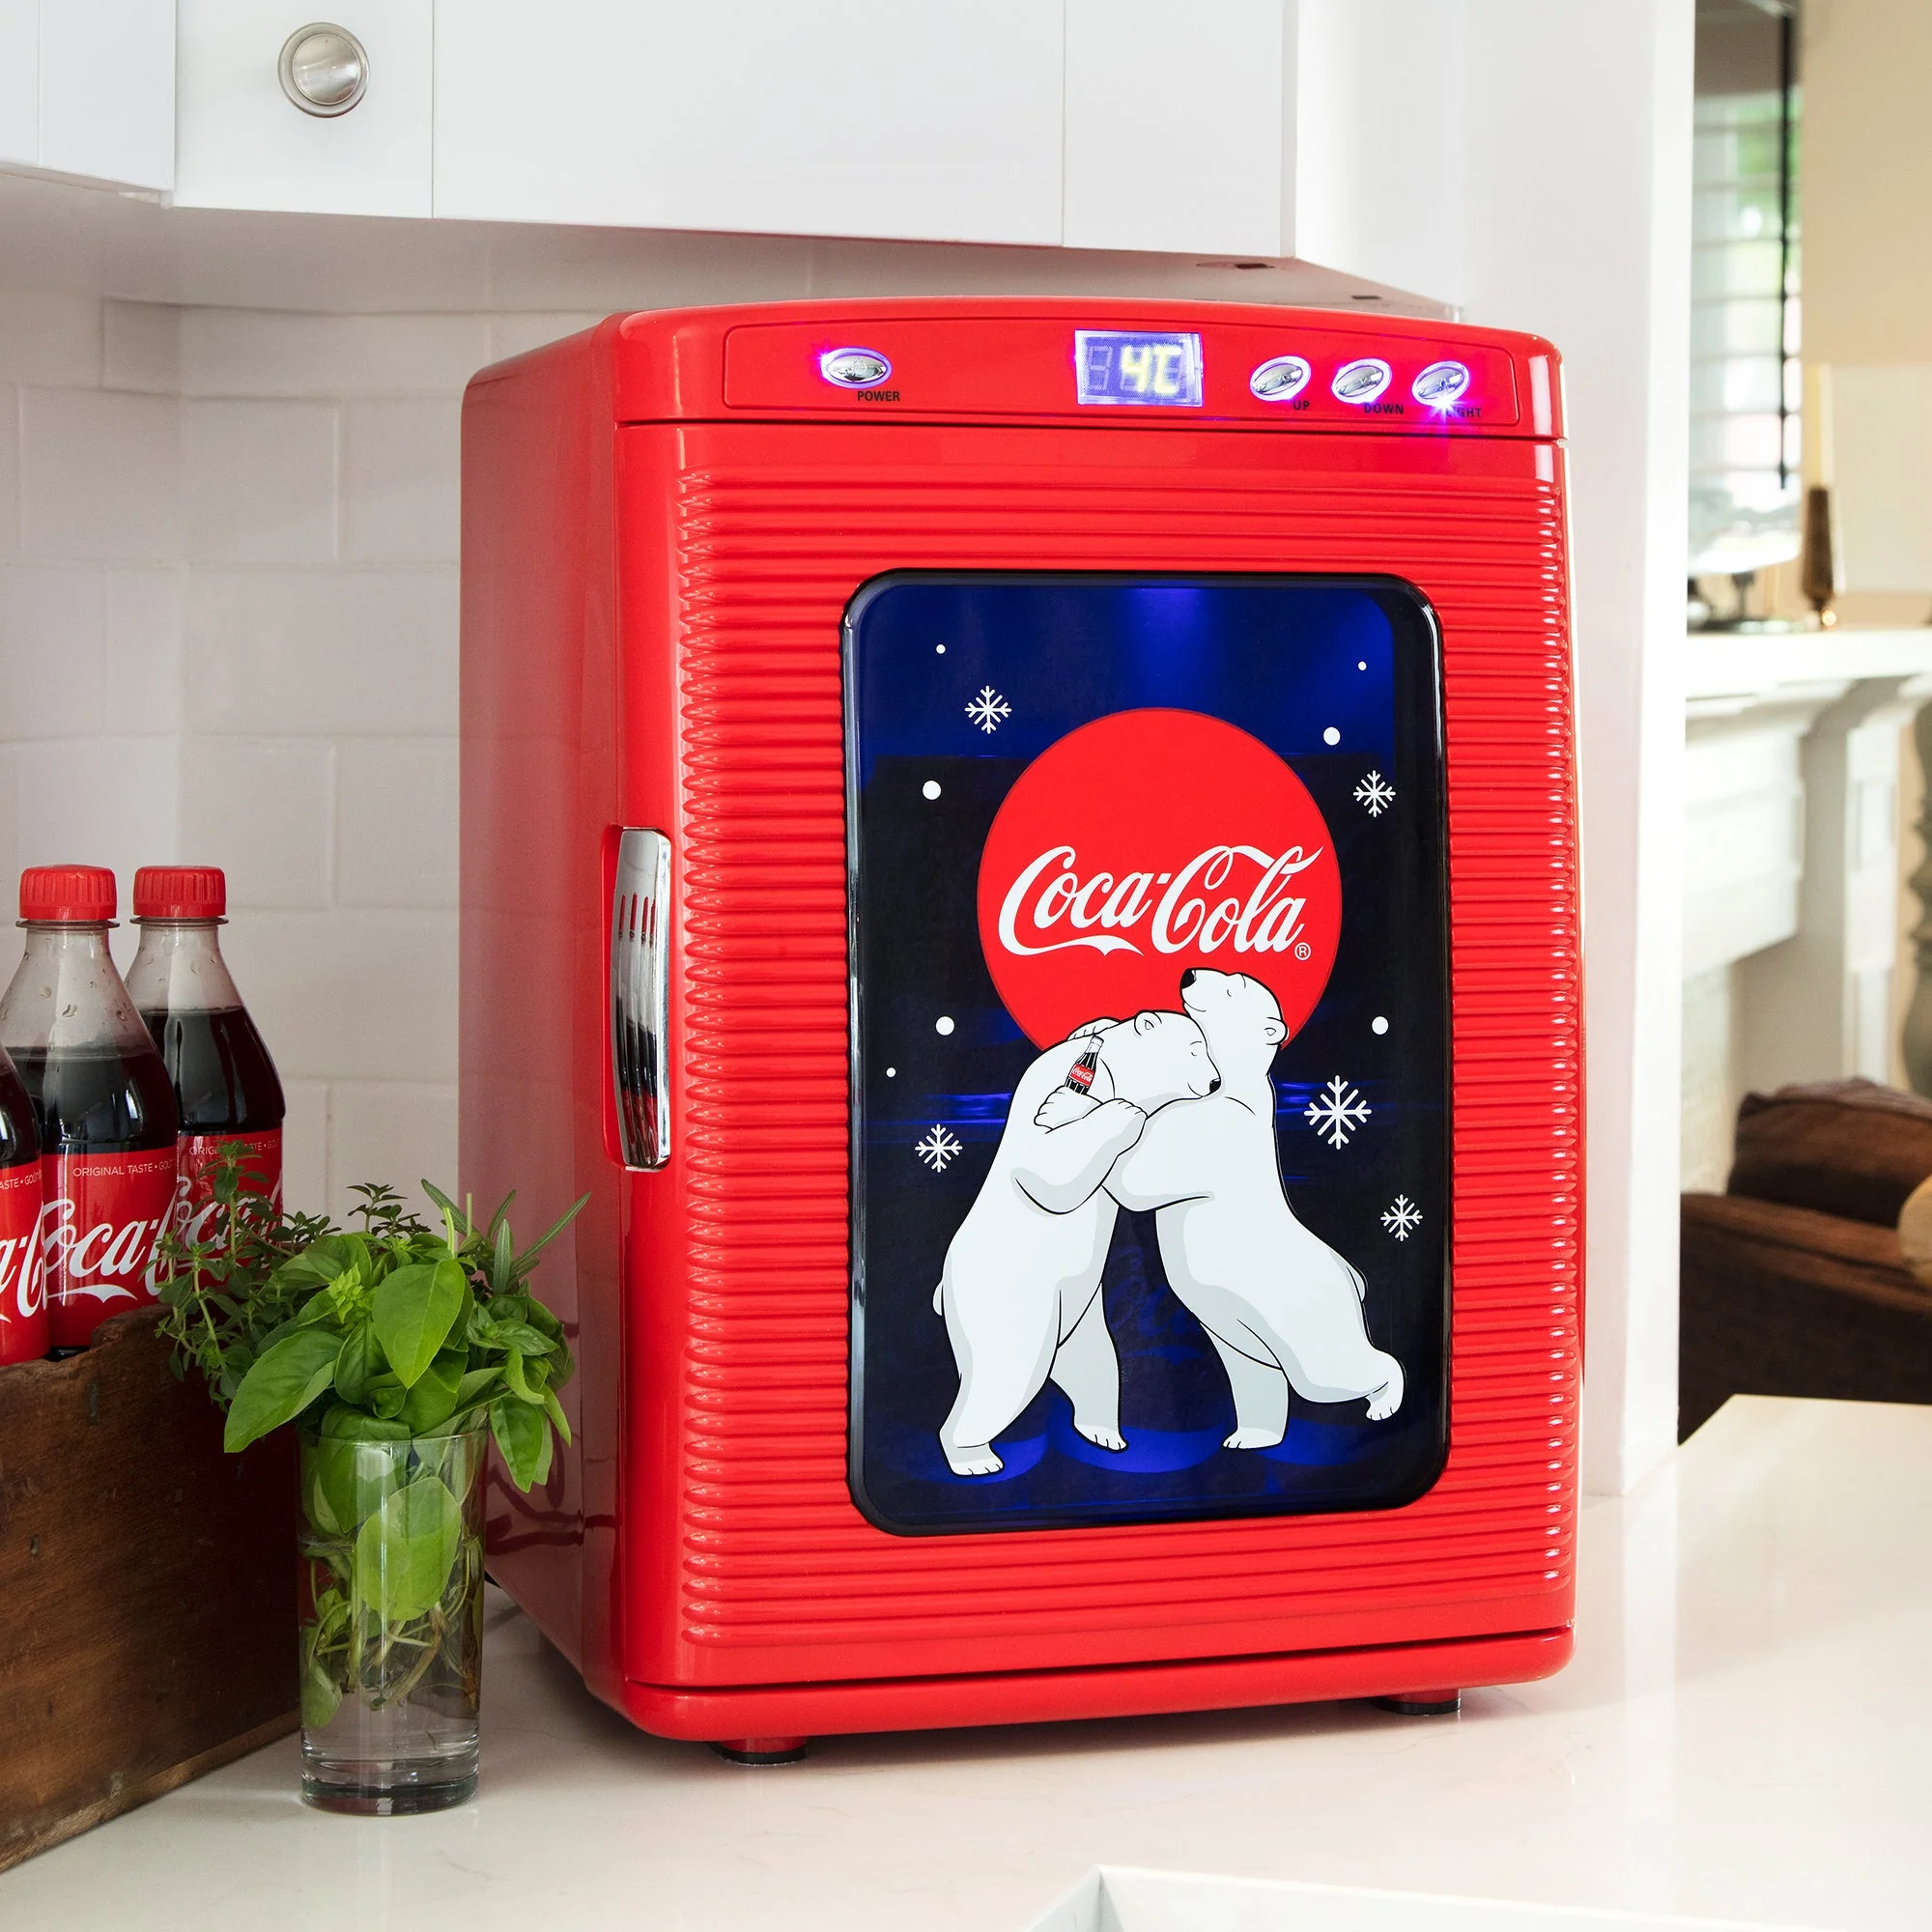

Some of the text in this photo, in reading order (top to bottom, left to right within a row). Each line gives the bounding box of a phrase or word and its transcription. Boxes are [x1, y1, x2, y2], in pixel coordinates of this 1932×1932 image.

[857, 390, 900, 402] POWER
[1293, 400, 1310, 411] UP
[1363, 402, 1404, 414] DOWN
[1445, 407, 1482, 418] LGHT
[998, 845, 1324, 956] Coca-Cola
[72, 1166, 125, 1178] ORIGINAL
[127, 1162, 154, 1174] TASTE
